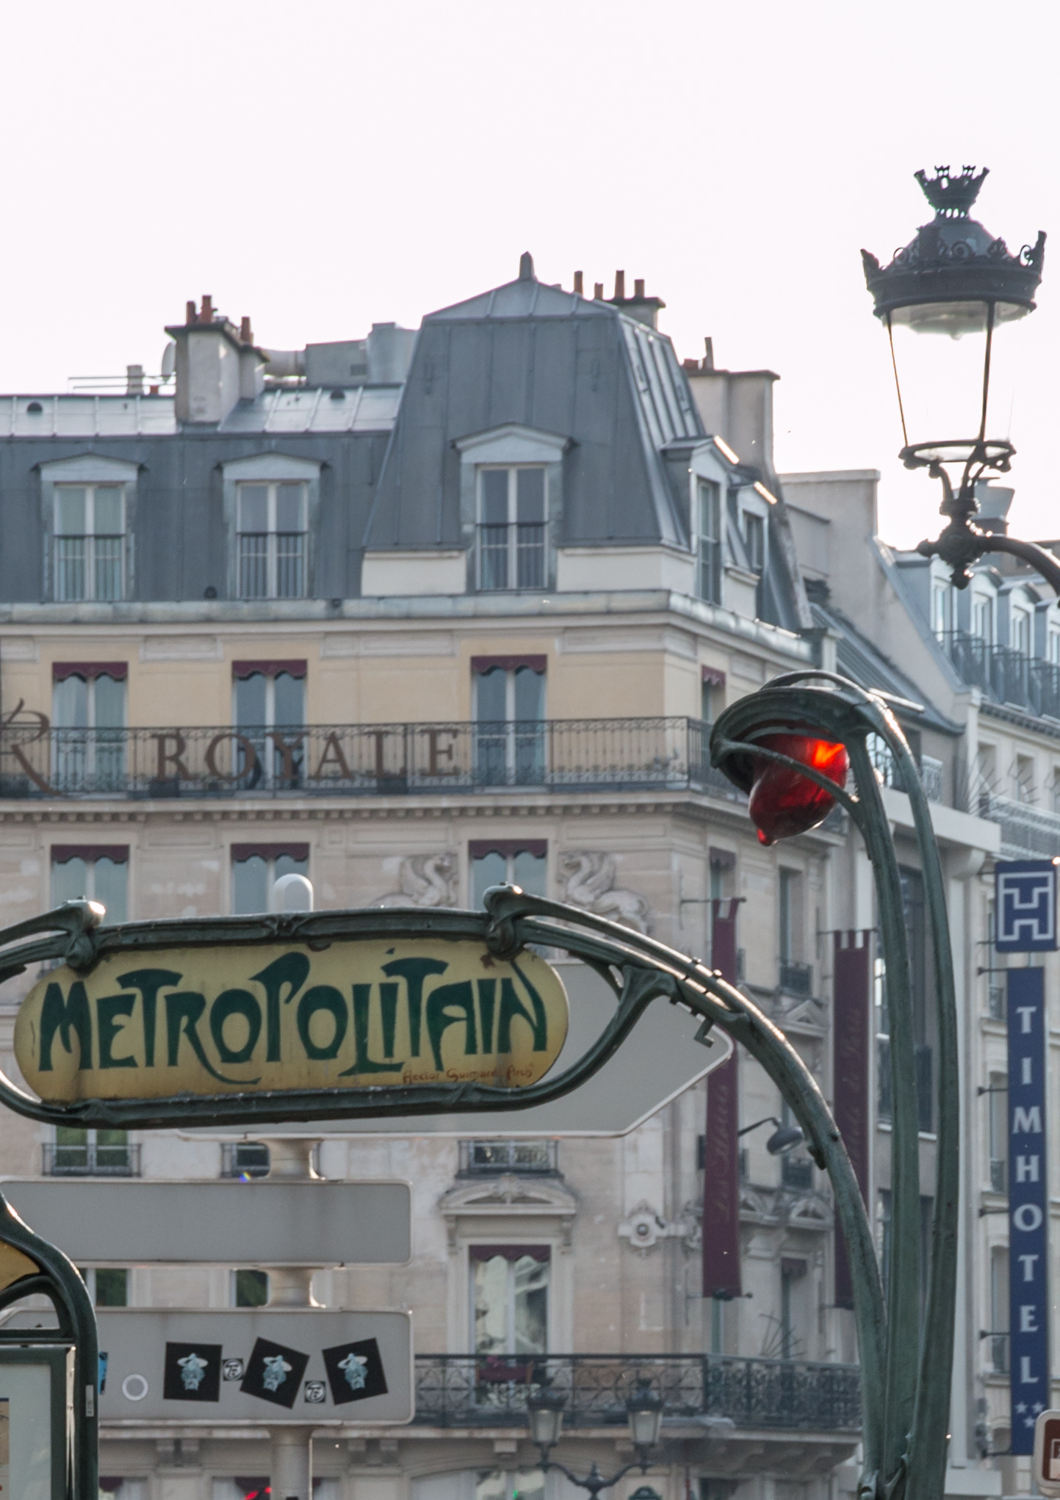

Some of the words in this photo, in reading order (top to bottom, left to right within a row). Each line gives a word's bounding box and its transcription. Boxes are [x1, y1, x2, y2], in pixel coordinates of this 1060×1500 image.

[151, 728, 460, 782] ROYALE
[37, 947, 549, 1086] METROPOLITAIN
[1012, 1005, 1042, 1384] TIMHOTEL
